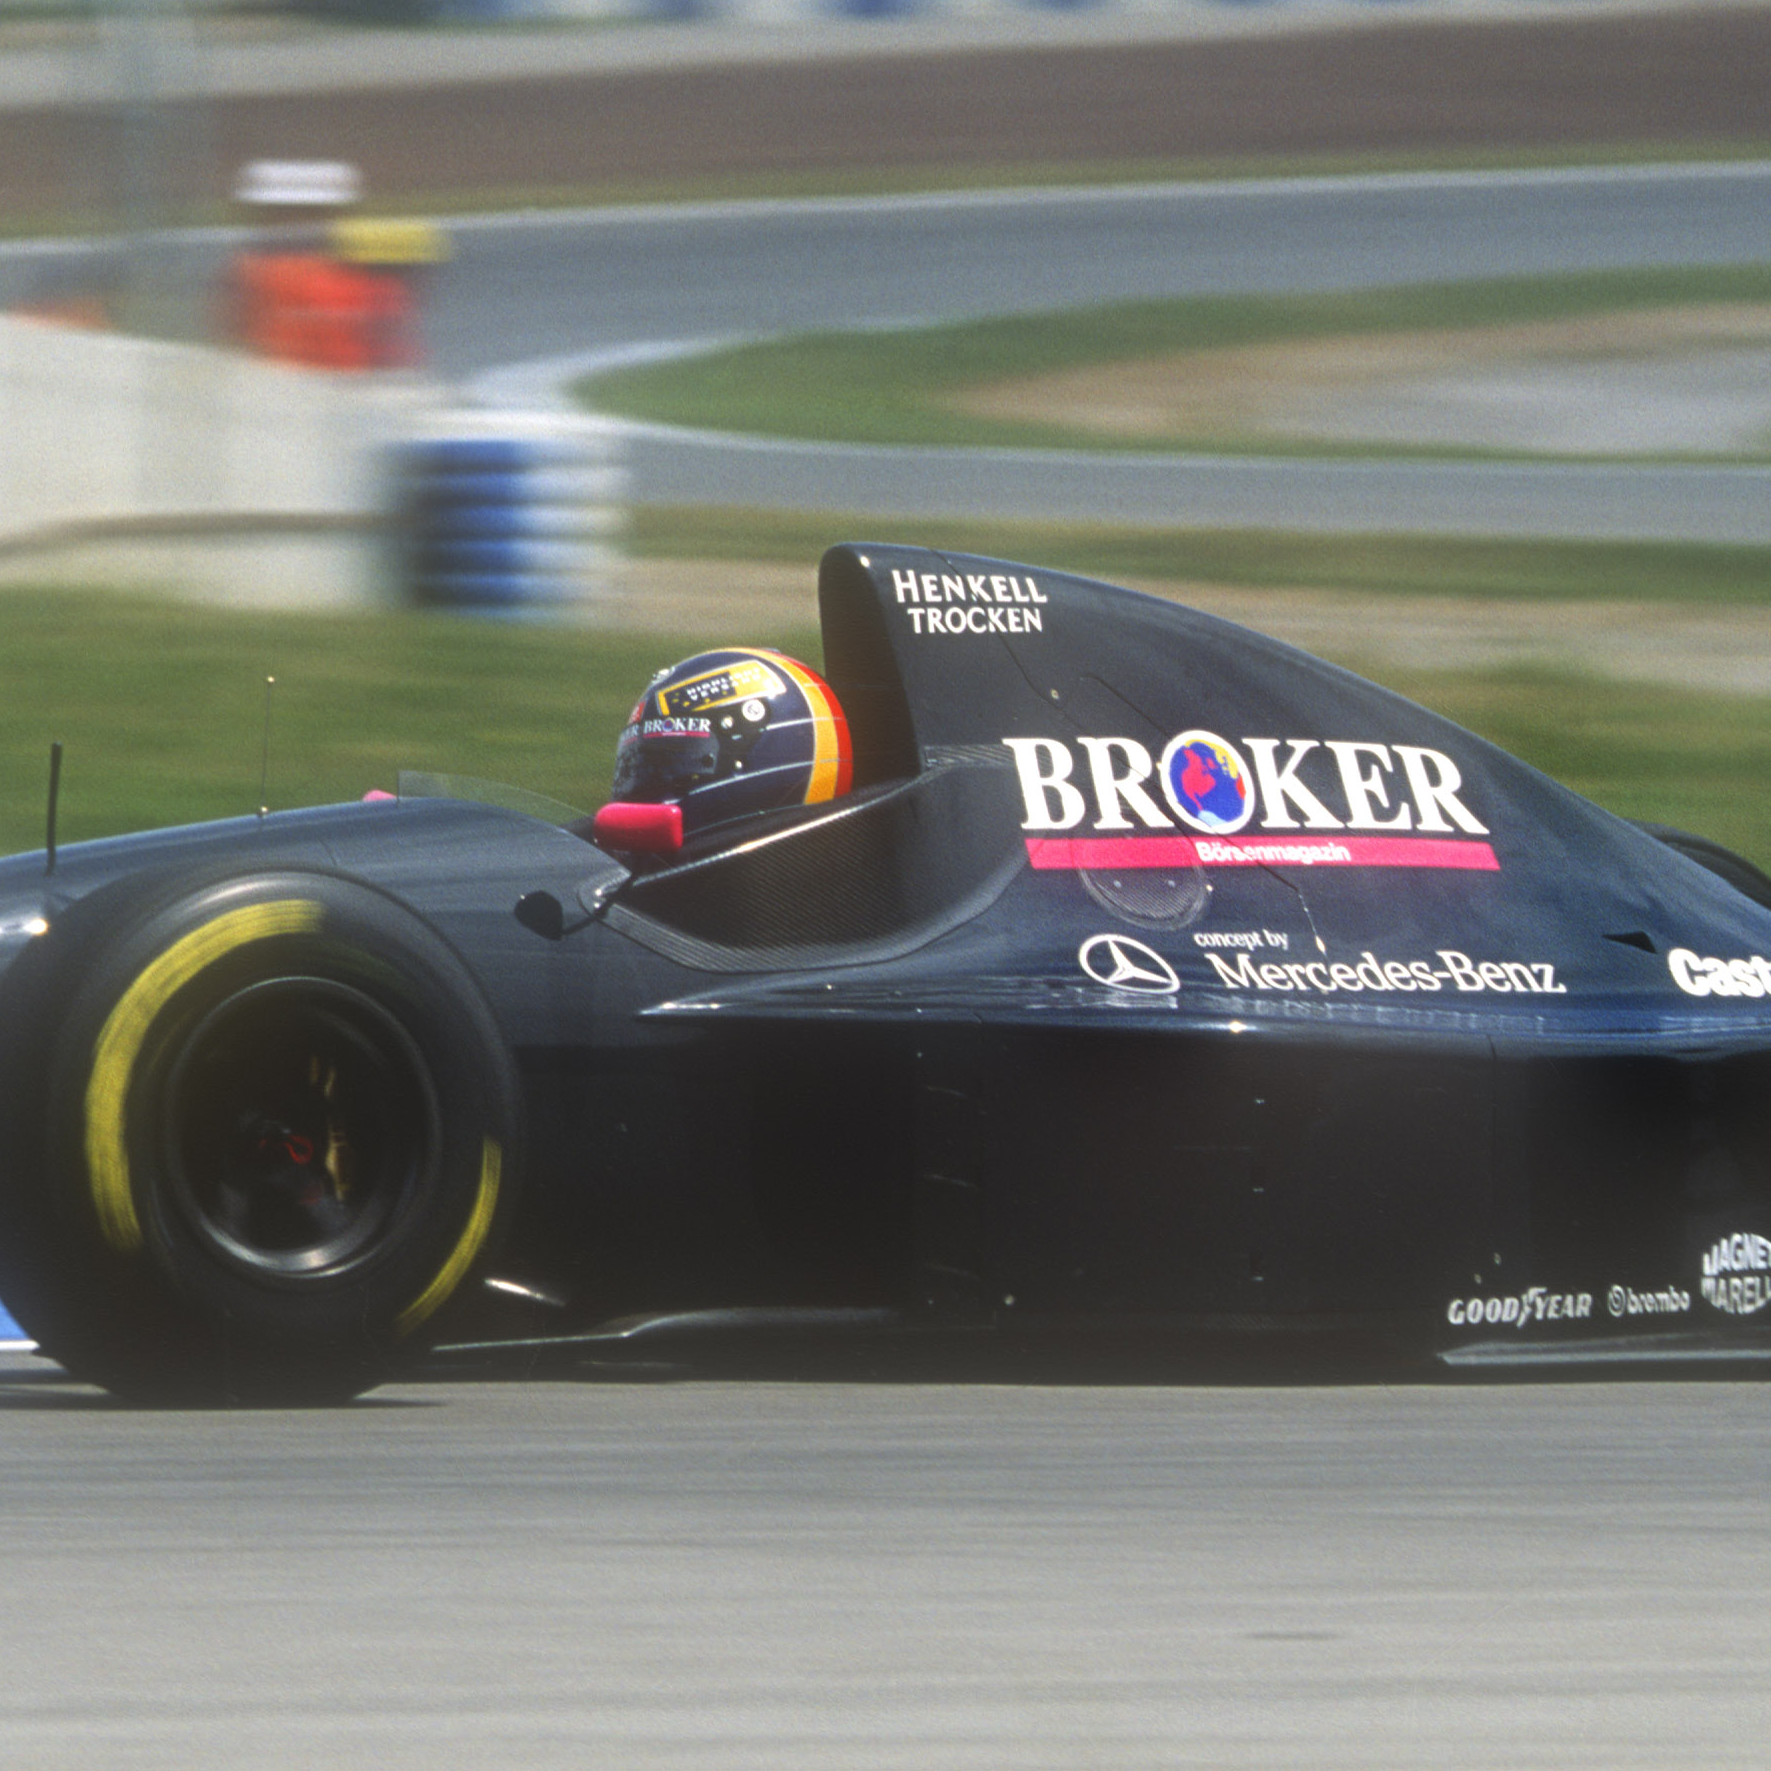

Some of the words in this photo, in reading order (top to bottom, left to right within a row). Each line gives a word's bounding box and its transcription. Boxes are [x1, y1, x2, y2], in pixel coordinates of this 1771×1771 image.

[891, 569, 1048, 603] HENKELL
[906, 606, 1043, 634] TROCKEN
[643, 718, 712, 732] BROKER
[1002, 730, 1491, 835] BROKER
[1195, 840, 1353, 865] Börsenmagazin
[1194, 930, 1265, 952] concept
[1262, 928, 1288, 951] by
[1204, 950, 1568, 994] Mercedes-Benz
[1447, 1286, 1594, 1328] GOODYEAR
[1626, 1285, 1692, 1316] brembo
